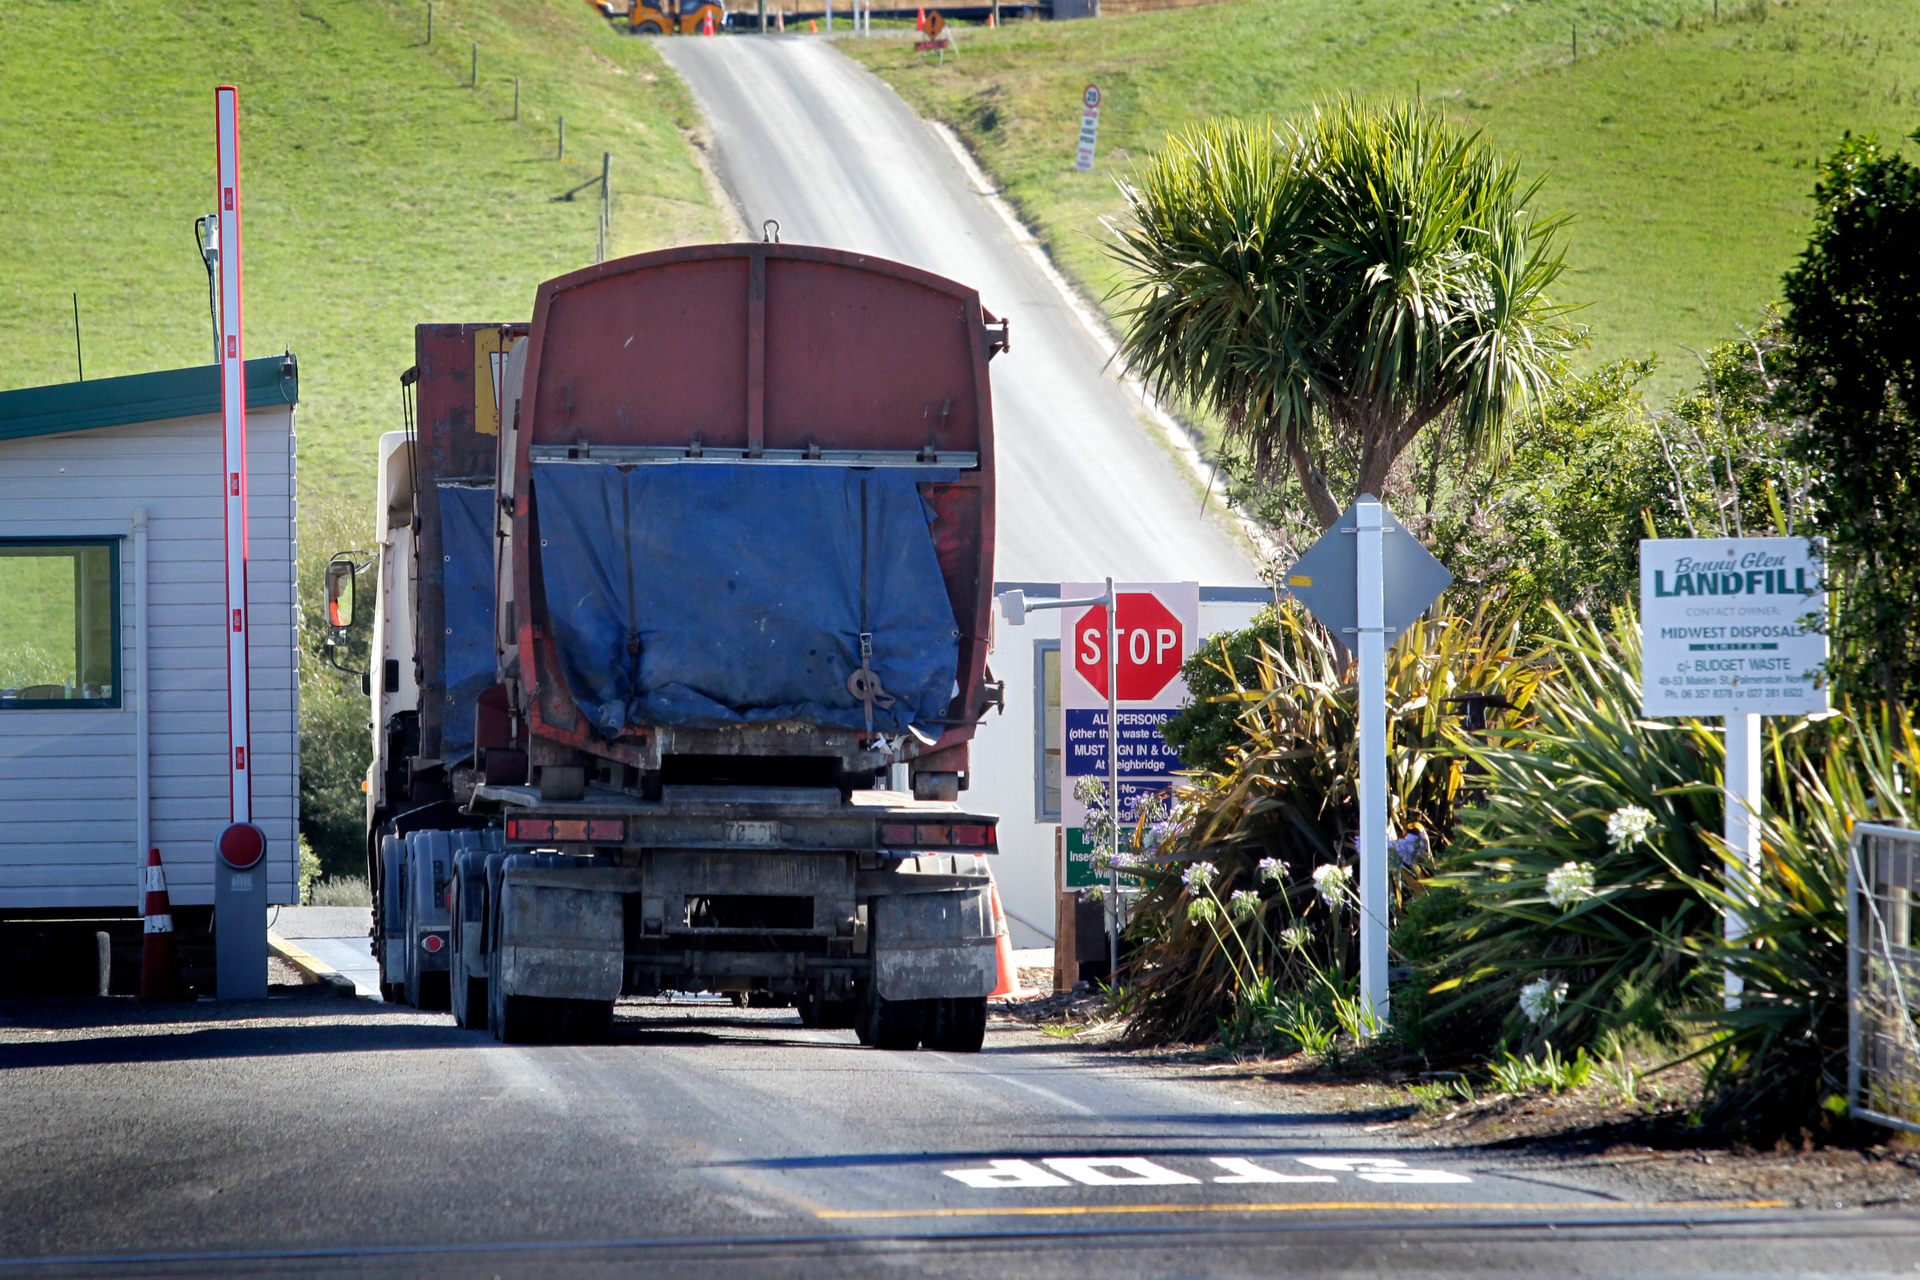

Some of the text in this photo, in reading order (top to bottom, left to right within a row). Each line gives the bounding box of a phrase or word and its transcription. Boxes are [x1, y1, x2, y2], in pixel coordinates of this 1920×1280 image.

[1740, 551, 1786, 569] Glen
[1654, 567, 1814, 598] LANDFILL
[1686, 606, 1782, 617] CONTACT OWNER:
[1661, 625, 1806, 639] MIDWEST DISPOSALS
[1081, 628, 1177, 665] STOP
[1694, 659, 1745, 672] BUDGET
[1749, 658, 1792, 671] WASTE
[1747, 688, 1763, 698] 027
[1117, 713, 1168, 725] PERSONS
[1069, 728, 1097, 741] (other
[1122, 729, 1150, 739] waste
[1074, 744, 1105, 756] MUST
[1136, 744, 1147, 756] IN
[1150, 744, 1159, 756] &
[1094, 759, 1165, 772] At eighbridge
[1121, 784, 1136, 794] No
